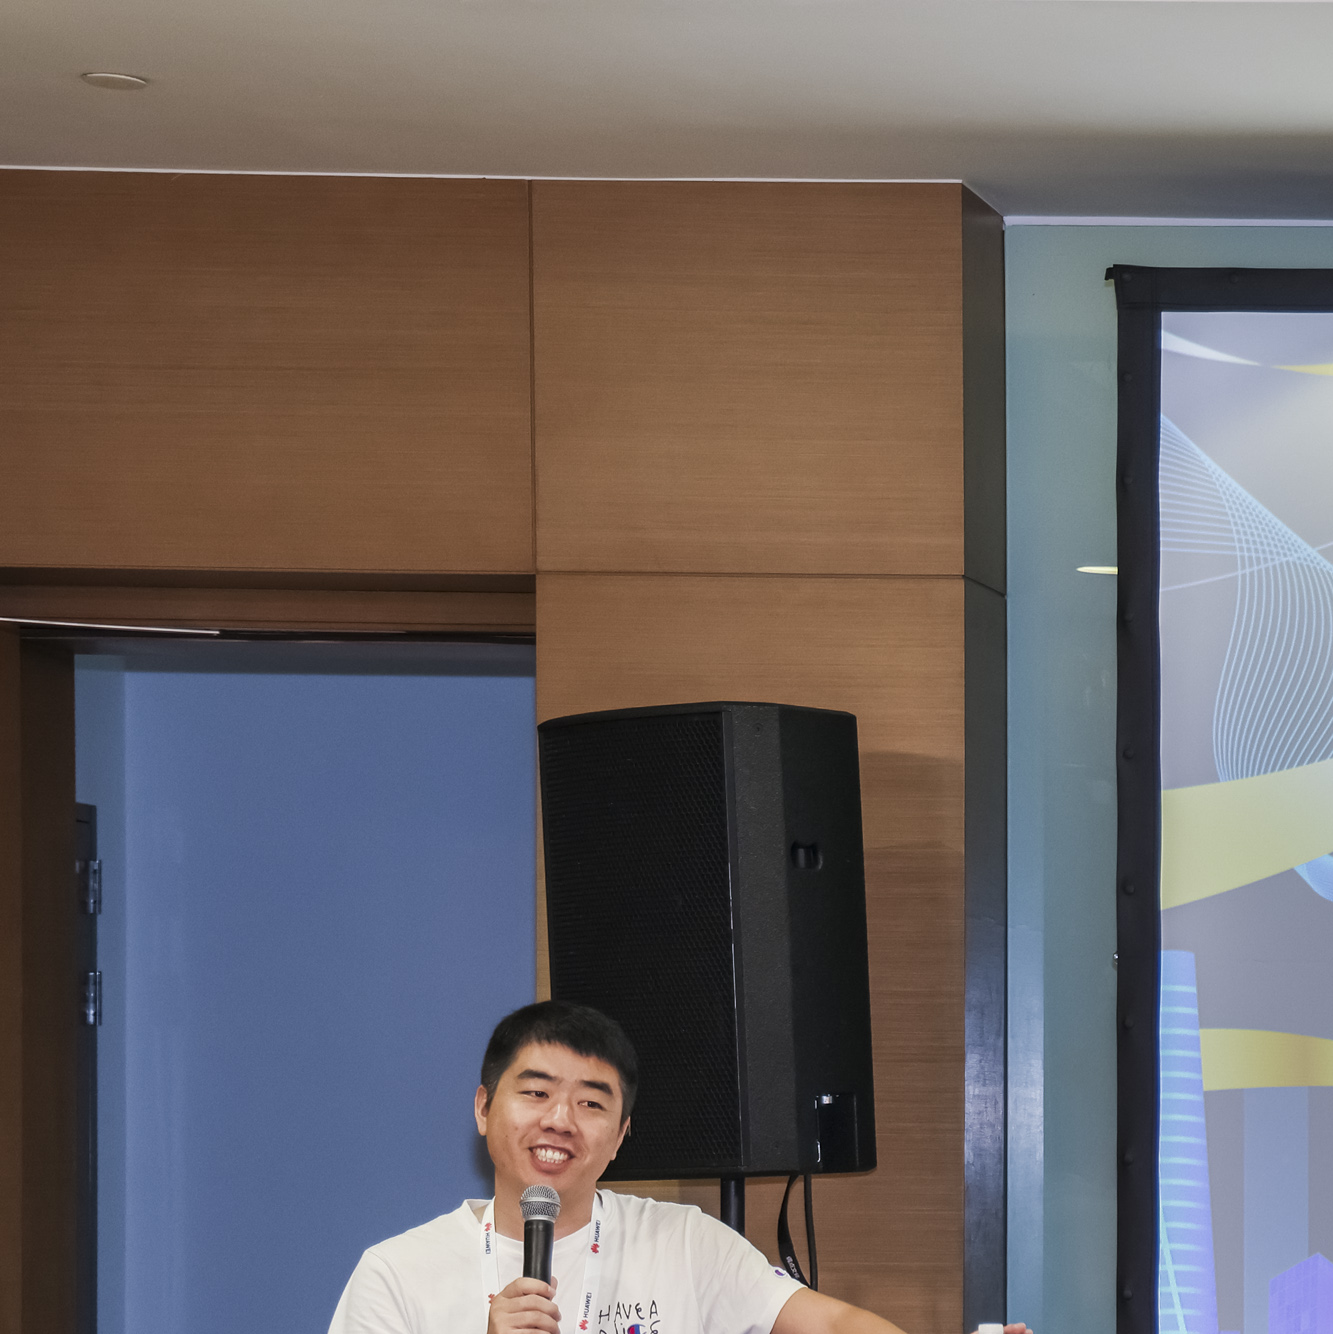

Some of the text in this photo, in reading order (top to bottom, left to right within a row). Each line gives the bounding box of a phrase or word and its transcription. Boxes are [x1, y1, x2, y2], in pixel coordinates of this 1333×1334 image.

[583, 1292, 592, 1318] HUAWEI
[598, 1299, 659, 1325] HAVE A
